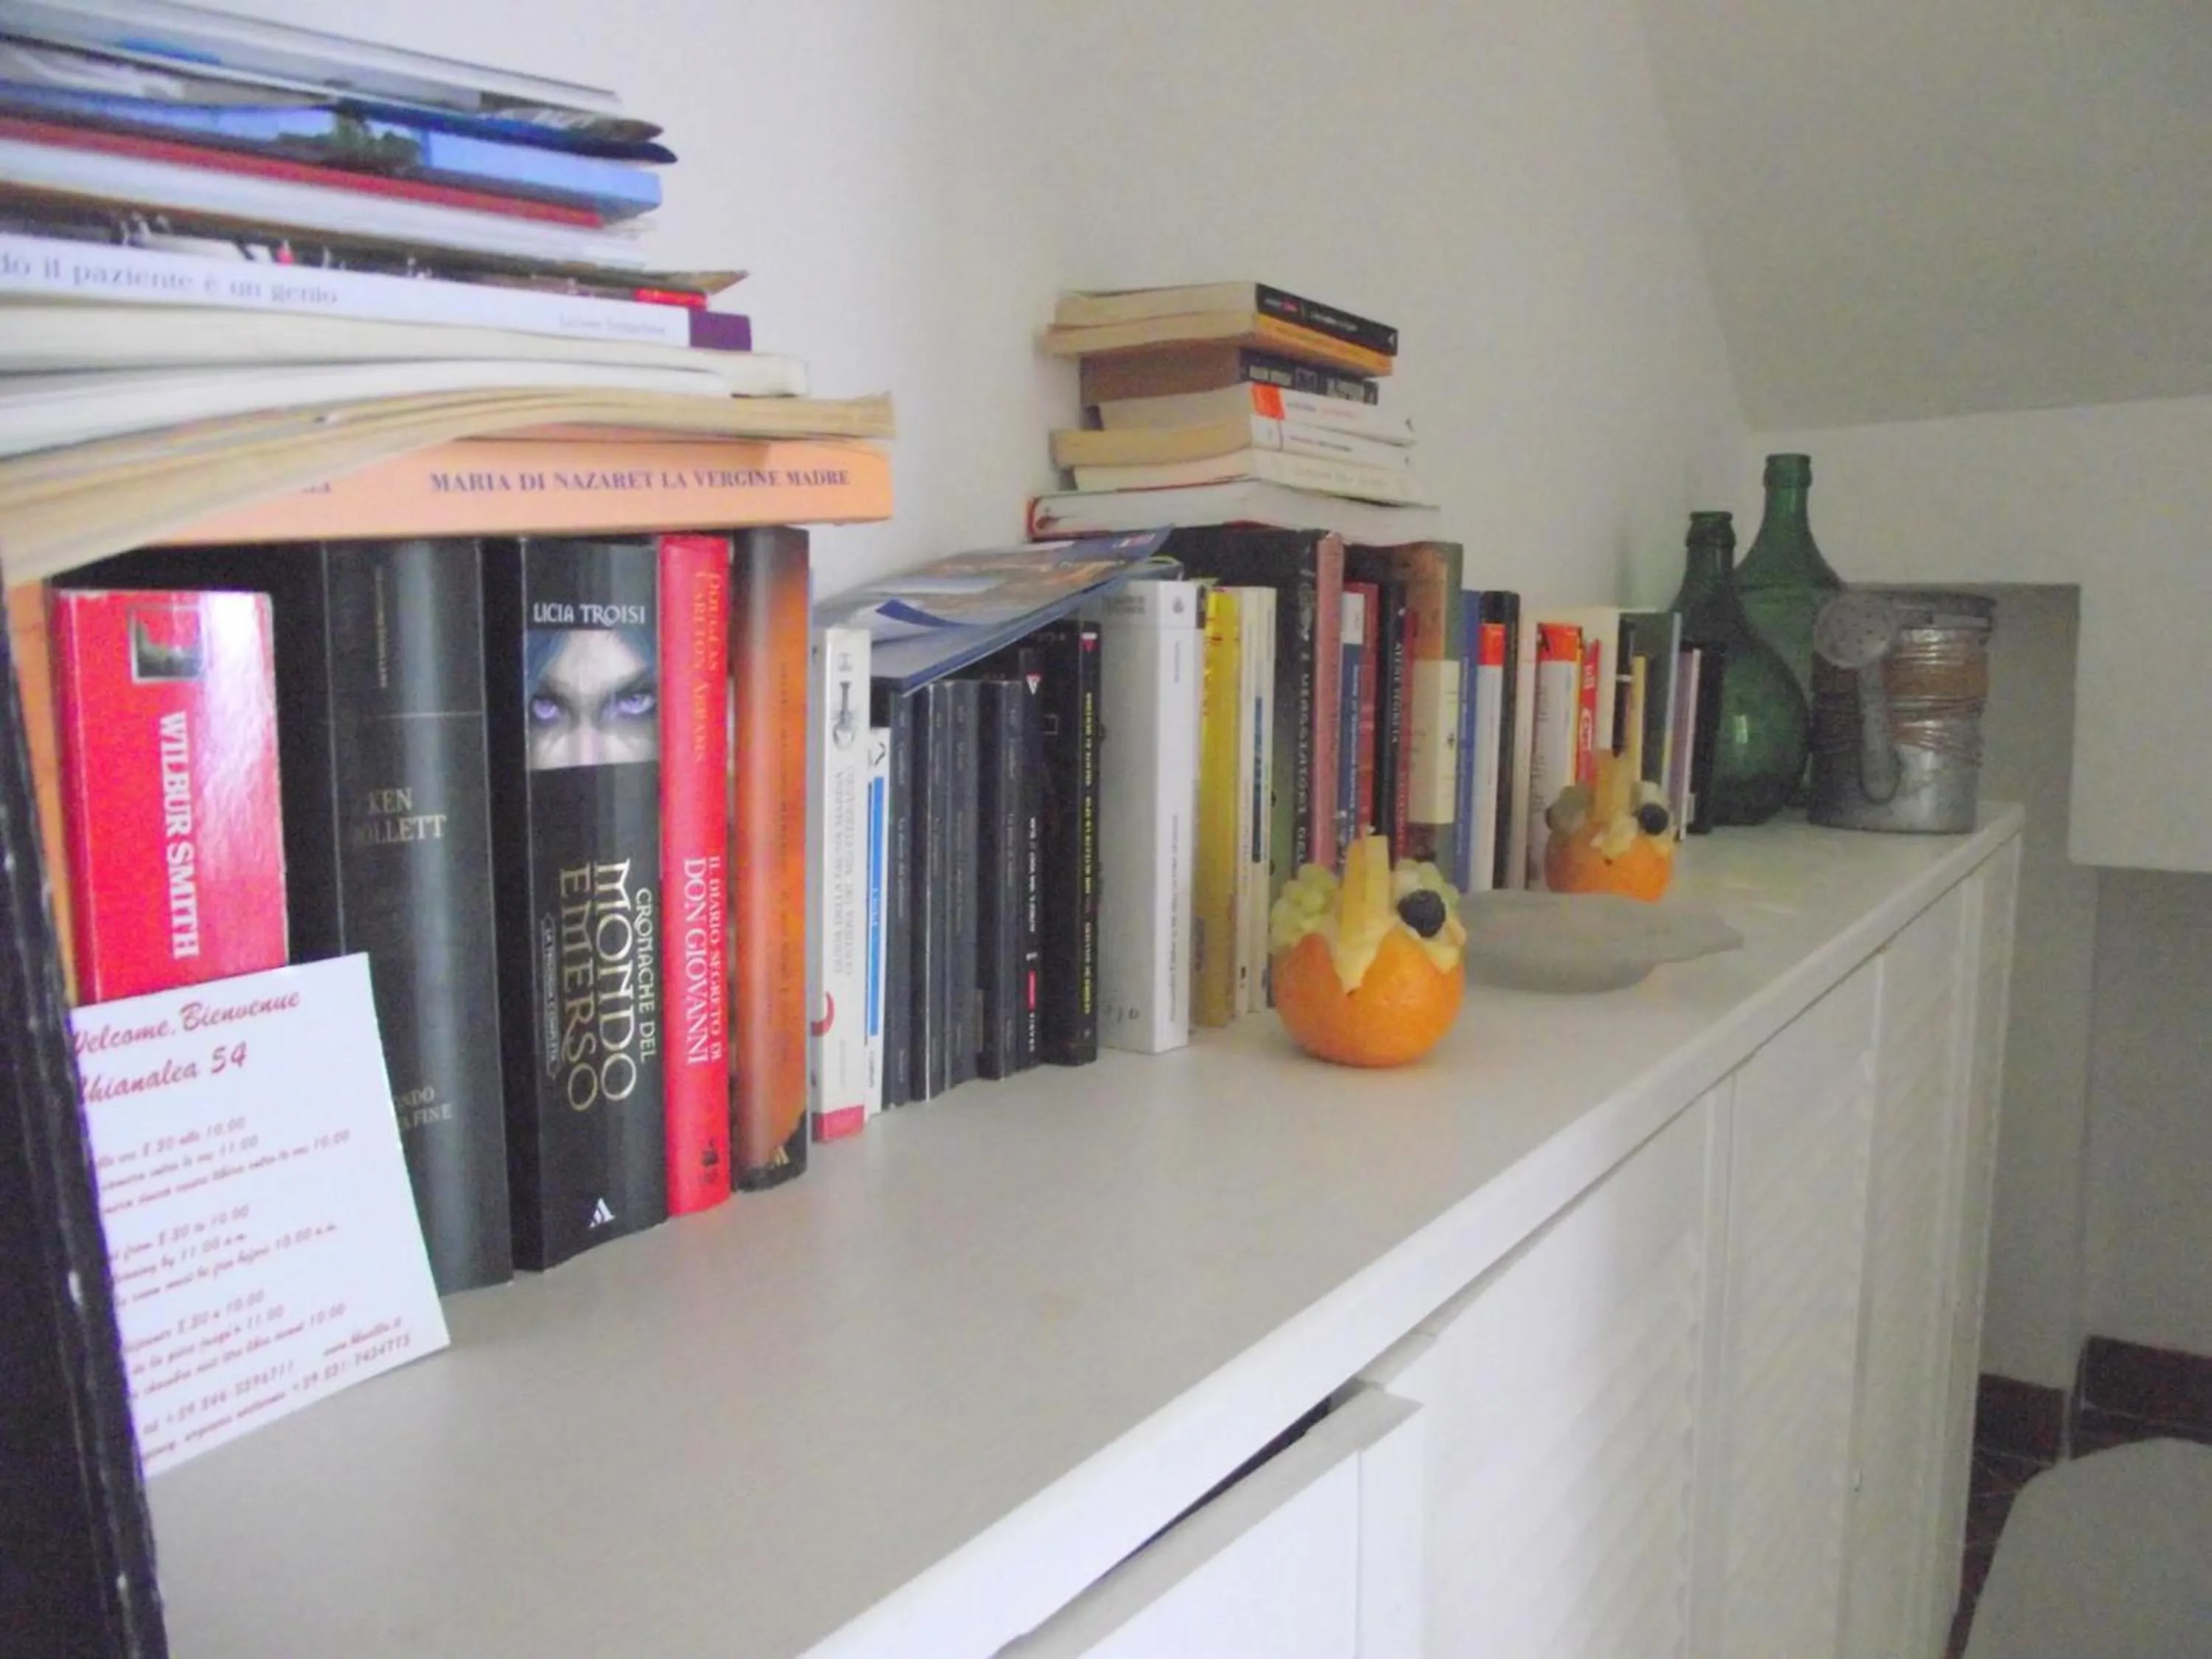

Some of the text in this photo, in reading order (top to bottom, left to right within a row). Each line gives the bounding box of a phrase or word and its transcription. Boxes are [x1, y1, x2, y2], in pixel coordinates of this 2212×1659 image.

[44, 255, 60, 279] il
[73, 260, 193, 291] paziente
[229, 279, 262, 296] un
[271, 282, 339, 305] genio
[431, 468, 850, 493] MARIA DI NAZARET LA VERGINE MADRE
[533, 602, 646, 627] LICIA TROISI
[160, 711, 201, 961] WILBUR SMITH
[353, 813, 448, 846] OLLETT
[593, 858, 637, 1102] MONDO
[636, 887, 656, 1065] CRONACHE DEL
[684, 857, 710, 1066] DON GIOVANNI
[179, 991, 302, 1032] Bienvenue
[560, 861, 599, 1113] EMERSO
[211, 1040, 248, 1074] 54
